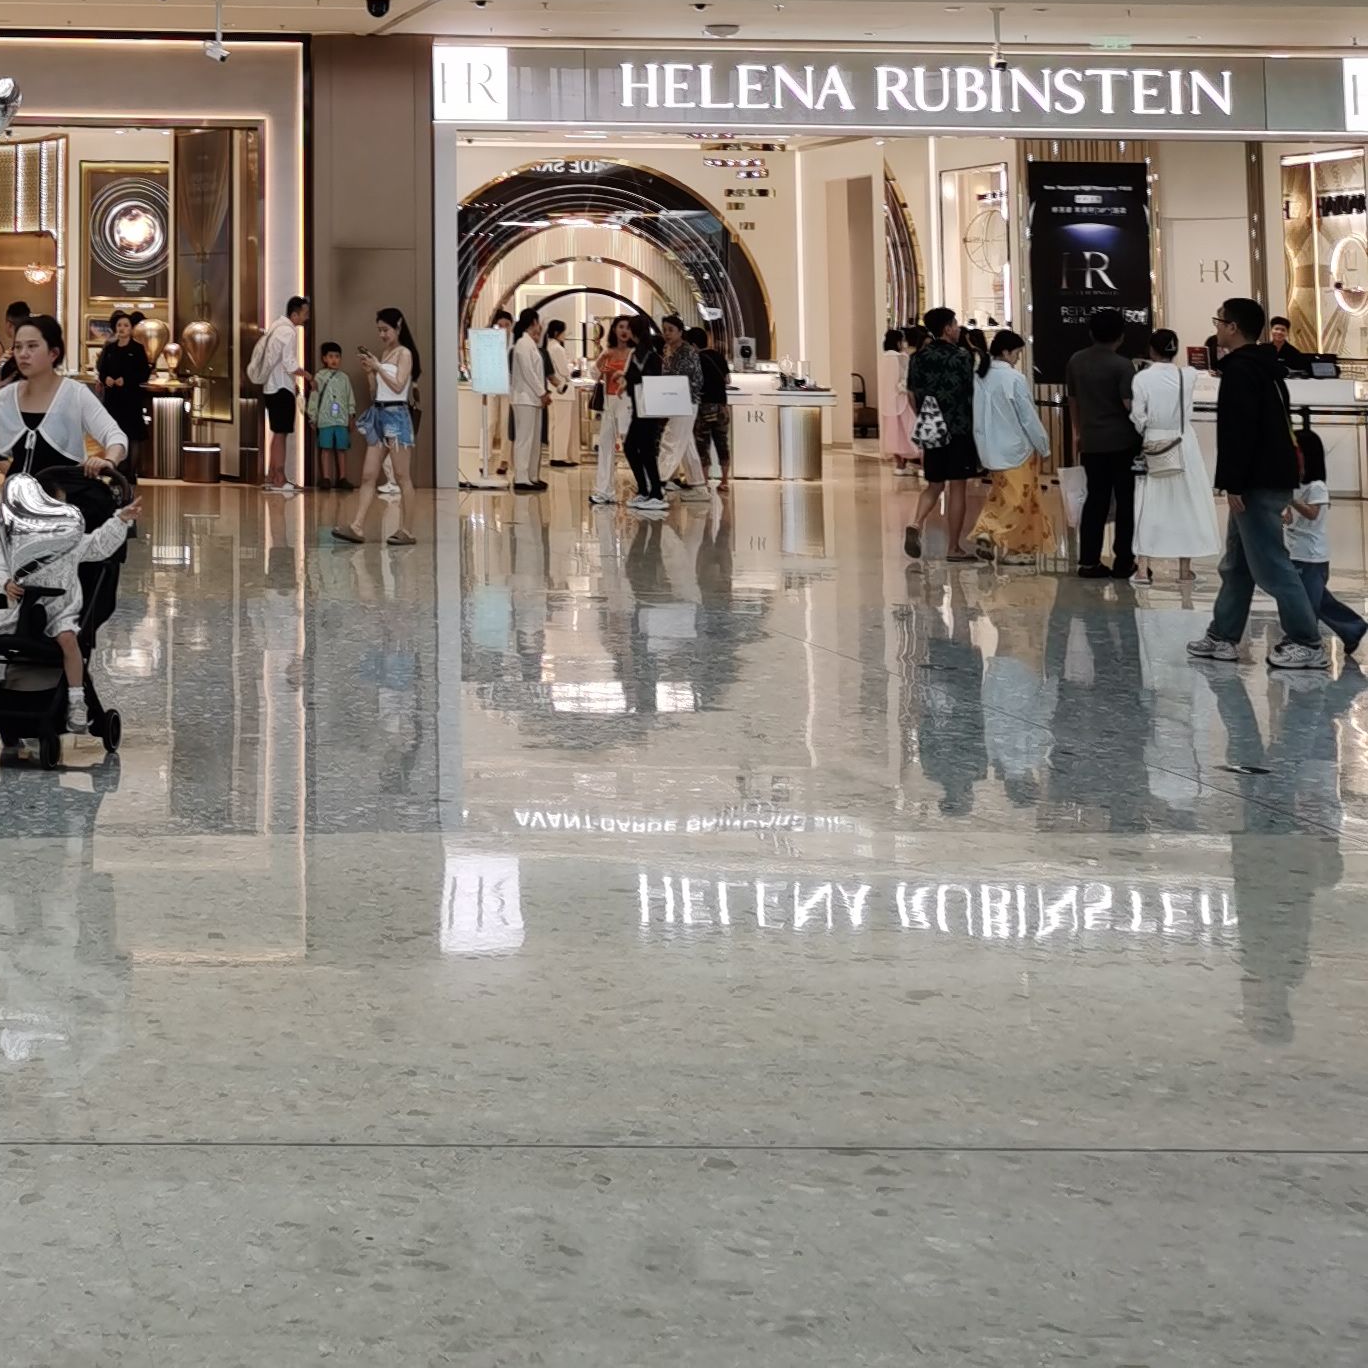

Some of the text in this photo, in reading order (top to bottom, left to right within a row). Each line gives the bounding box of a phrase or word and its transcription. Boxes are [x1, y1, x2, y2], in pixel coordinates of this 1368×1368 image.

[619, 62, 1233, 116] HELENA RUBINSTEIN
[1199, 258, 1234, 283] HR
